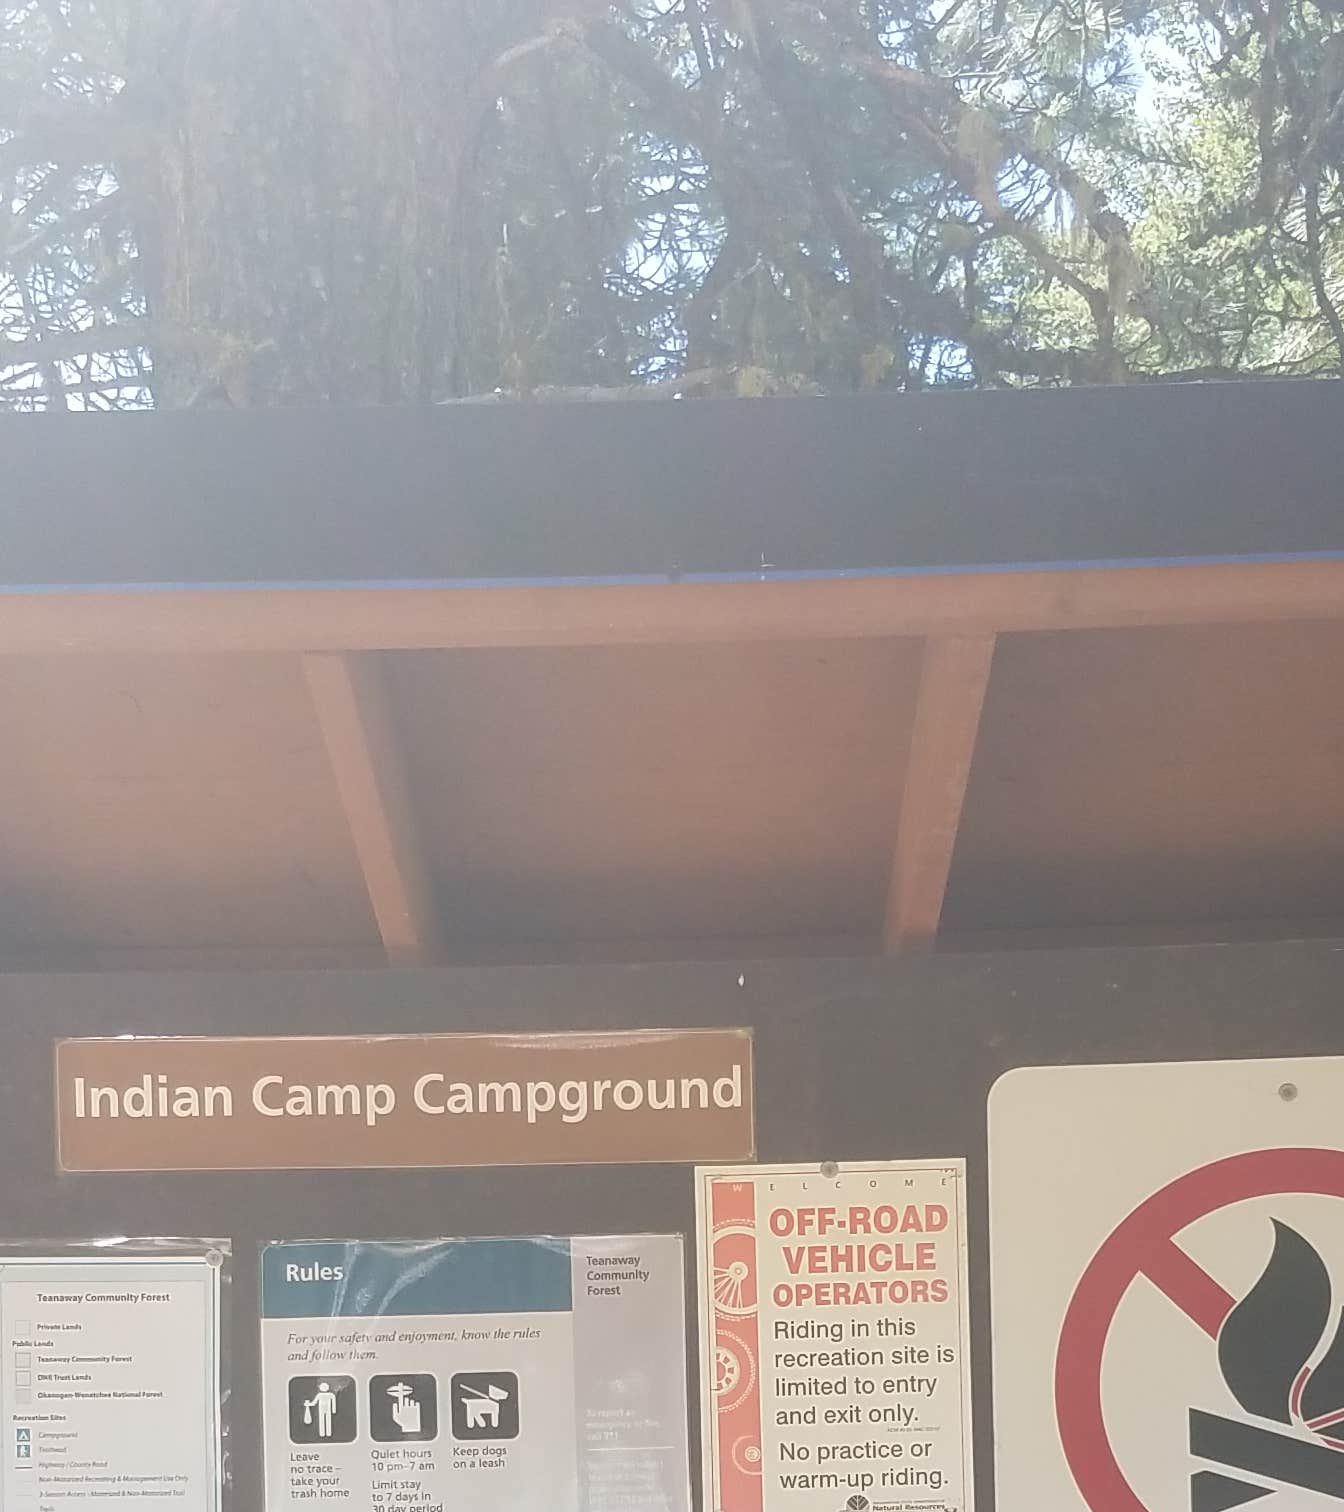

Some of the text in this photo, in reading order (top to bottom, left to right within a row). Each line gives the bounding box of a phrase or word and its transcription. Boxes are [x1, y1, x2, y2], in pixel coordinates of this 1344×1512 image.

[74, 1065, 742, 1125] Indian Camp Campground
[770, 1205, 948, 1237] OFF-ROAD
[587, 1255, 640, 1267] Teanaway
[783, 1243, 936, 1274] VEHICLE
[287, 1264, 343, 1282] Rules
[587, 1269, 649, 1282] Community
[587, 1285, 620, 1295] Forest
[773, 1279, 948, 1307] OPERATORS
[37, 1293, 169, 1303] Teanaway Community Forest
[775, 1318, 915, 1342] Riding in this
[288, 1334, 307, 1345] For
[311, 1335, 336, 1346] your
[374, 1331, 395, 1342] and
[462, 1329, 490, 1341] know
[494, 1328, 511, 1339] the
[513, 1328, 540, 1339] rules
[288, 1349, 378, 1363] and follow them.
[775, 1345, 954, 1367] recreation site is
[776, 1376, 937, 1396] limited to entry
[776, 1404, 918, 1426] and exit only.
[291, 1453, 319, 1462] Leave
[371, 1449, 432, 1460] Quiet hours
[453, 1446, 507, 1457] Keep dogs
[780, 1441, 932, 1464] No practice or
[307, 1465, 333, 1473] trace
[372, 1463, 383, 1472] 10
[454, 1459, 505, 1469] on a leash
[291, 1477, 339, 1487] take your
[372, 1480, 421, 1490] Limit stay
[780, 1468, 948, 1490] warm-up riding.
[291, 1489, 349, 1498] trash home
[372, 1493, 383, 1501] to
[386, 1493, 392, 1501] 7
[395, 1492, 418, 1503] days
